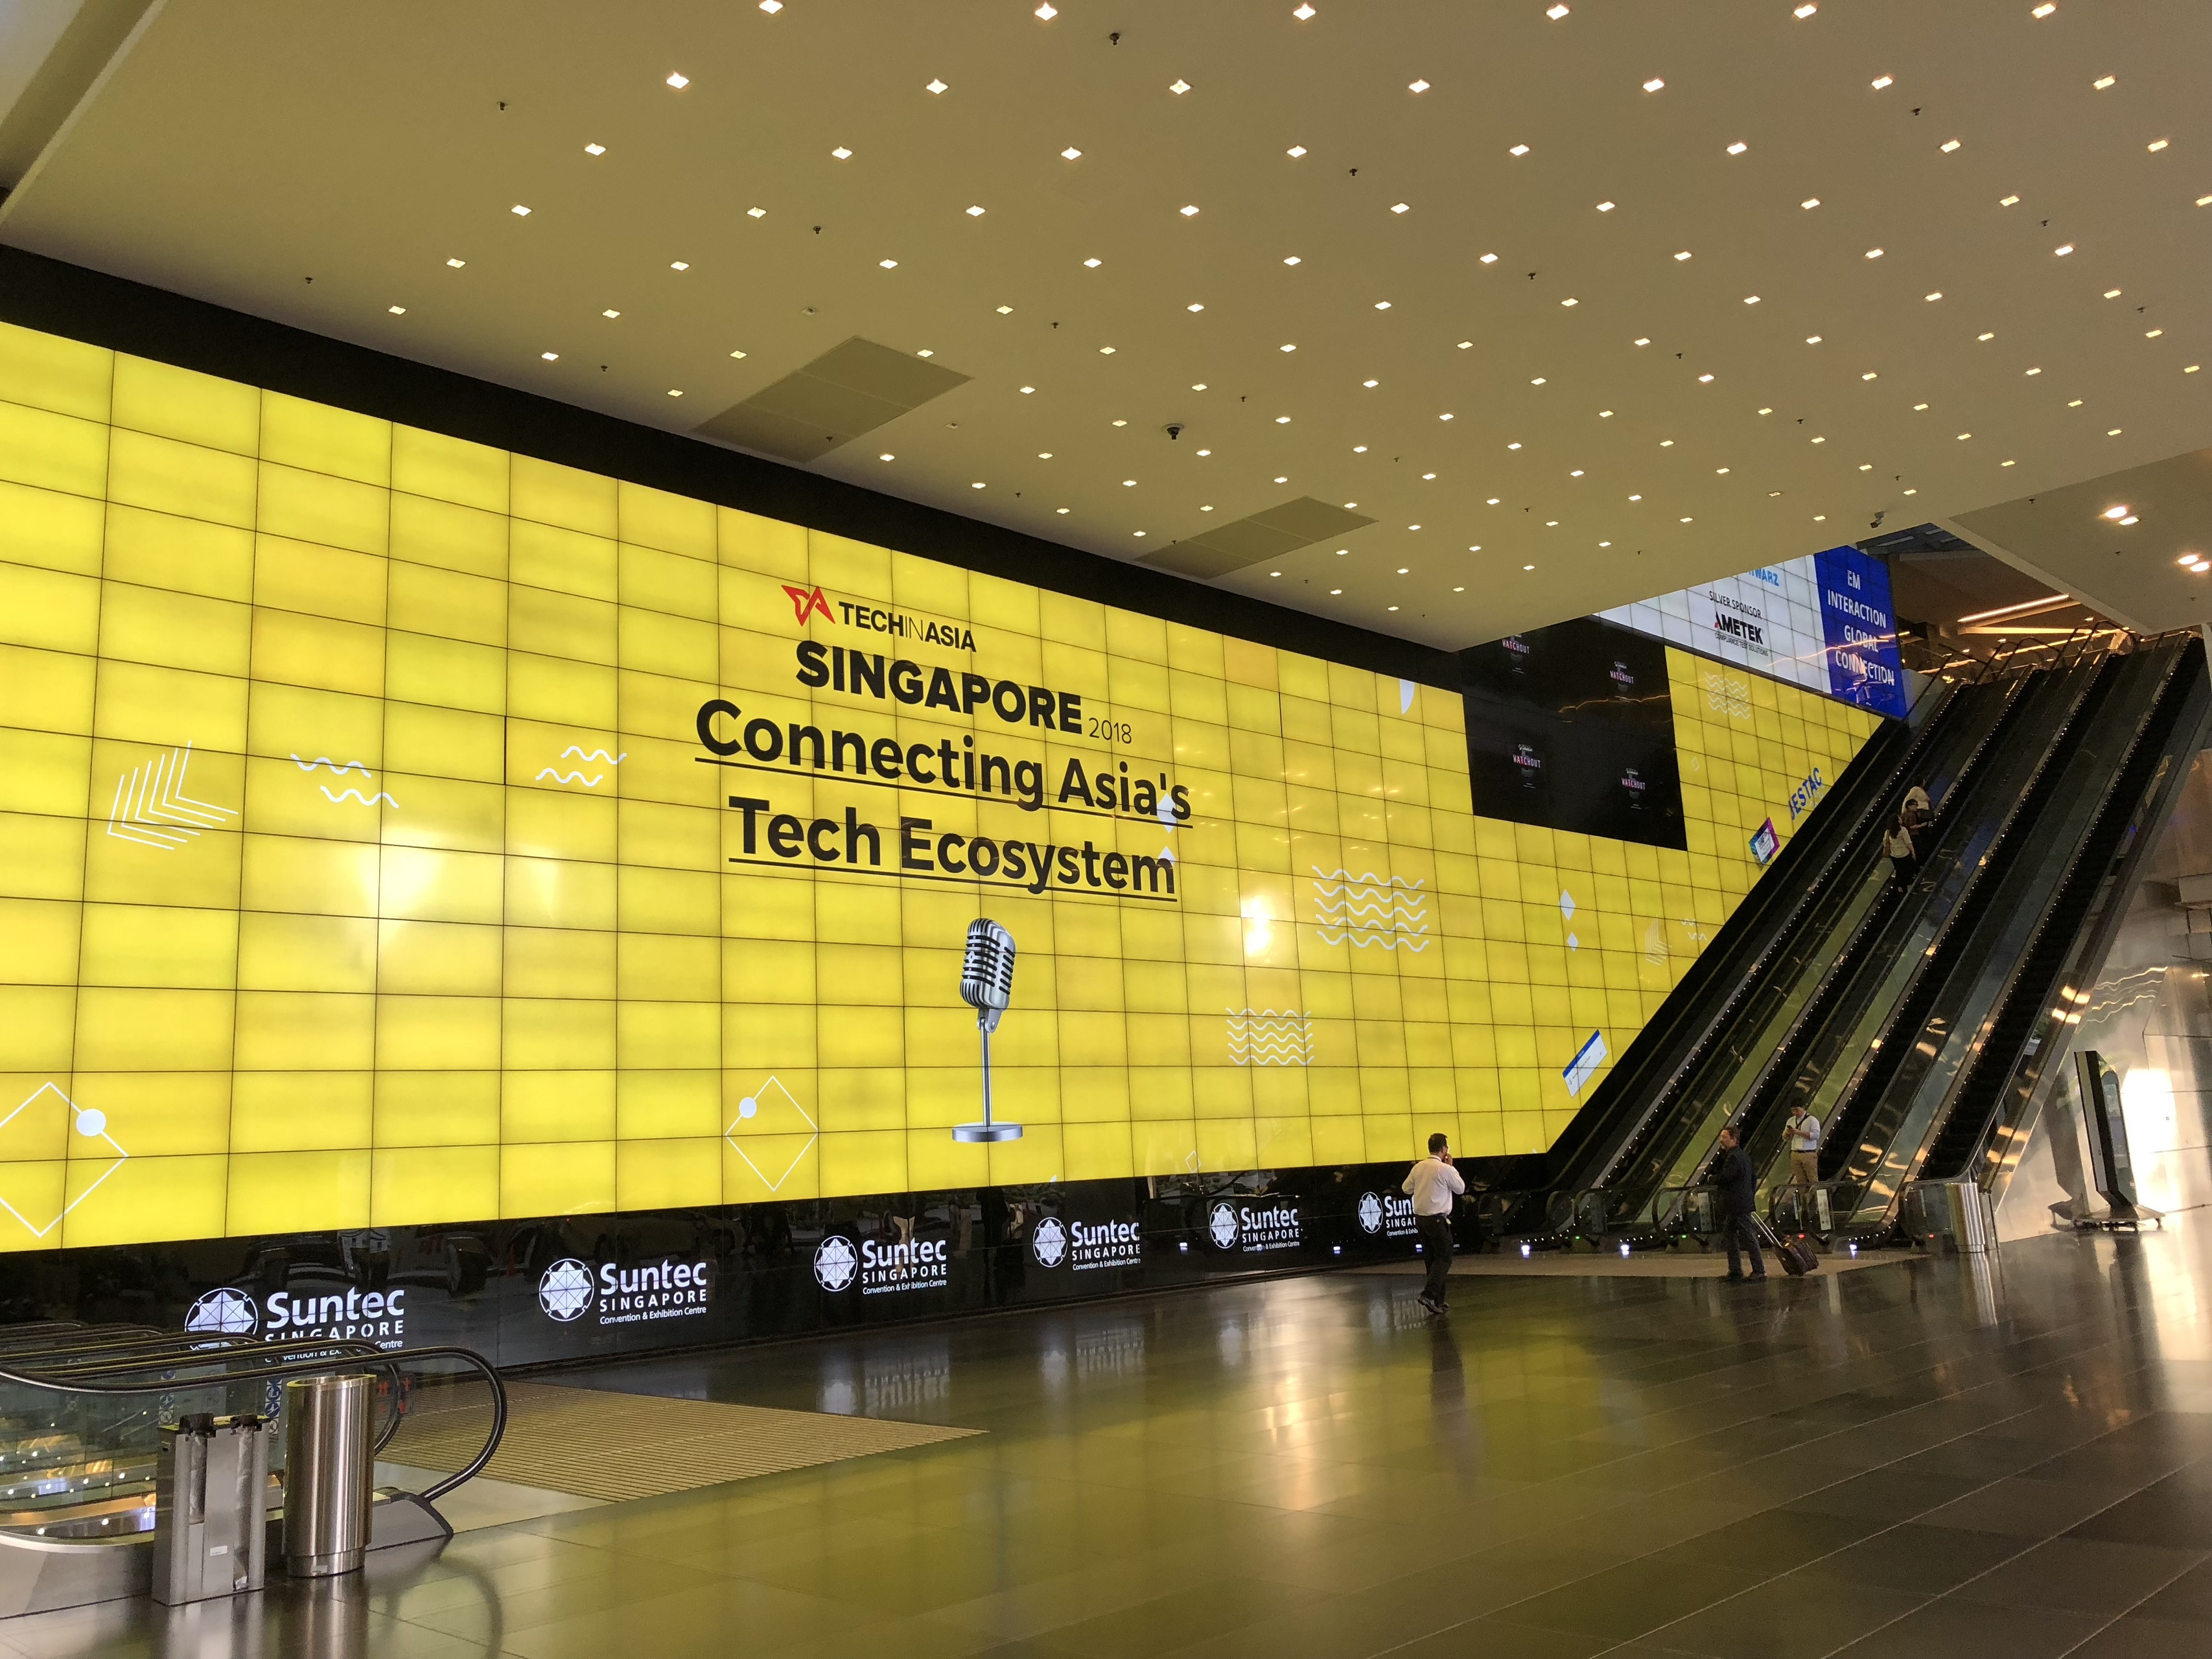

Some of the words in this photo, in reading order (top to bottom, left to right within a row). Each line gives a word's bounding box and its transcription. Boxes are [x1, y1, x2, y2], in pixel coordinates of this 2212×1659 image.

[1847, 570, 1861, 590] EM
[1709, 590, 1731, 608] SILVER
[1732, 599, 1763, 620] SPONSOR
[1828, 589, 1887, 628] INTERACTION
[1714, 611, 1764, 645] AMETEK
[1845, 625, 1879, 653] GLOBAL
[1502, 639, 1530, 654] WATCHOUT
[1609, 670, 1634, 684] WATCHOUT
[1835, 650, 1895, 686] CONNECTION
[795, 640, 1082, 734] SINGAPORE
[1088, 717, 1132, 745] 2018
[696, 699, 1042, 811] Connecting
[1058, 757, 1191, 820] Asia's
[1513, 754, 1541, 768] WATCHOUT
[1621, 777, 1646, 790] WATCHOUT
[729, 796, 881, 866] Tech
[902, 815, 1175, 894] Ecosystem
[1384, 1194, 1416, 1217] Sun
[1240, 1205, 1299, 1231] Suntec
[1386, 1216, 1416, 1228] SINGA
[1071, 1219, 1140, 1247] Suntec
[1242, 1228, 1299, 1243] SINGAPORE
[862, 1236, 947, 1268] Suntec
[1072, 1244, 1140, 1260] SINGAPORE
[600, 1259, 707, 1295] Suntec
[862, 1263, 947, 1284] SINGAPORE
[1073, 1261, 1099, 1271] Convention
[1104, 1259, 1126, 1267] Exhibition
[863, 1284, 895, 1295] Convention
[929, 1279, 947, 1288] Centre
[266, 1286, 405, 1329] Suntec
[600, 1289, 707, 1313] SINGAPORE
[600, 1313, 641, 1325] Convention
[642, 1312, 648, 1320] &
[649, 1308, 683, 1319] Exhibition
[684, 1306, 707, 1316] Centre
